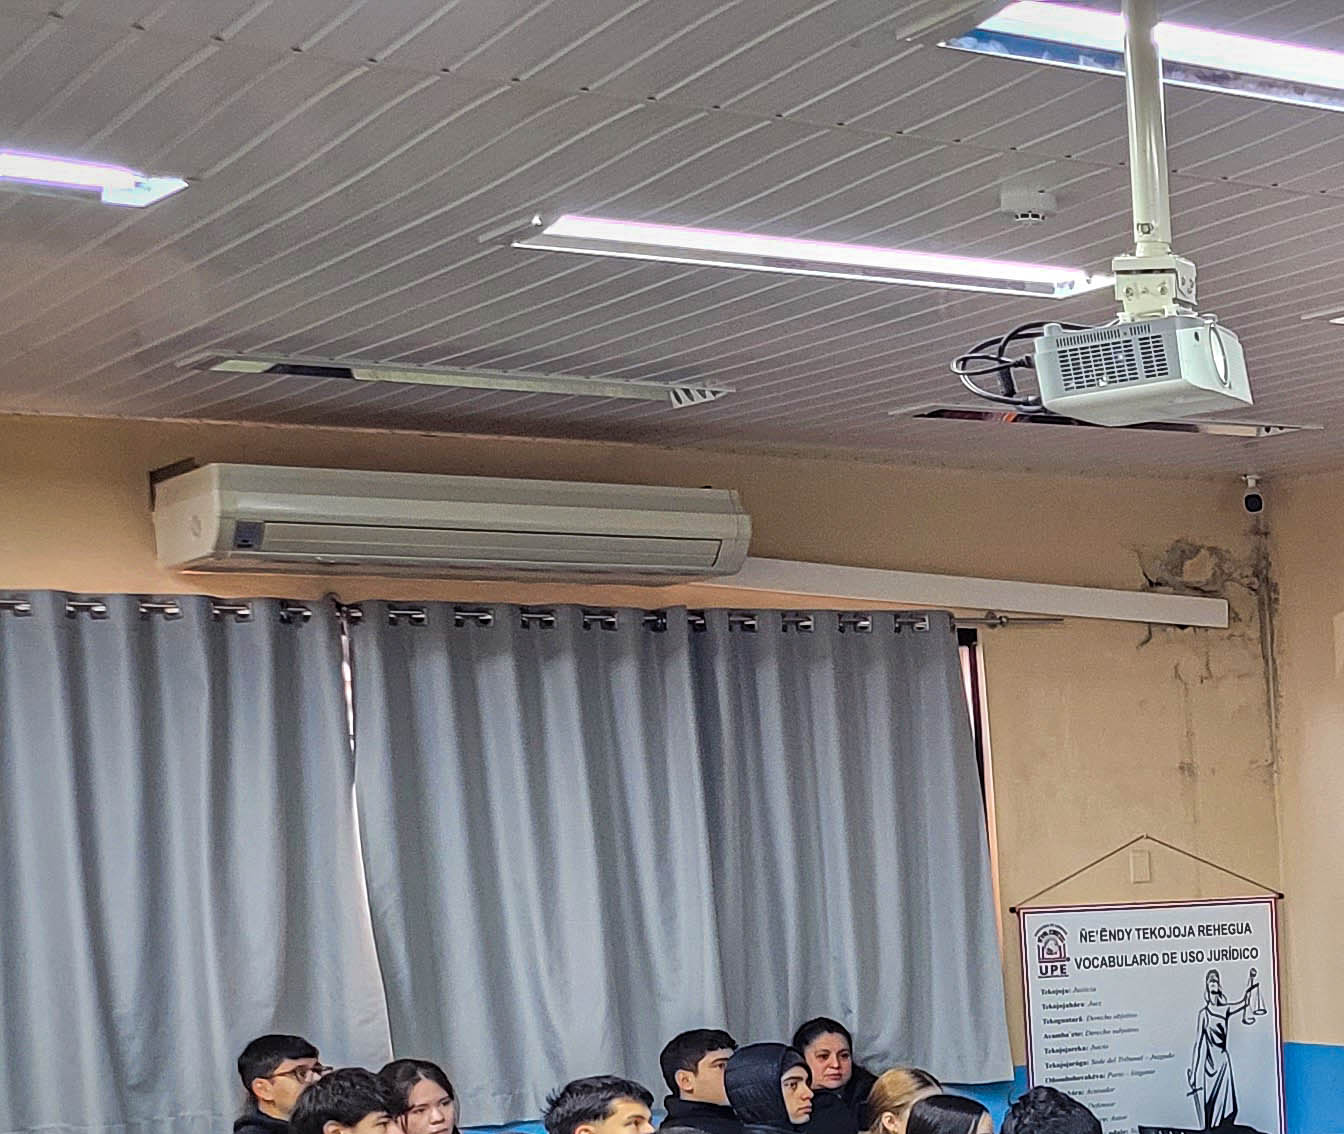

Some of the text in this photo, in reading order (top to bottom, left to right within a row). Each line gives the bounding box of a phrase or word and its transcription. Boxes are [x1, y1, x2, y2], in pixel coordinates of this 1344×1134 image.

[1135, 925, 1196, 940] TEKOJOJA
[1197, 922, 1253, 937] REHEGUA
[1075, 945, 1260, 970] VOCABULARIO DE USO JURÍDICO
[1040, 964, 1067, 976] UPE
